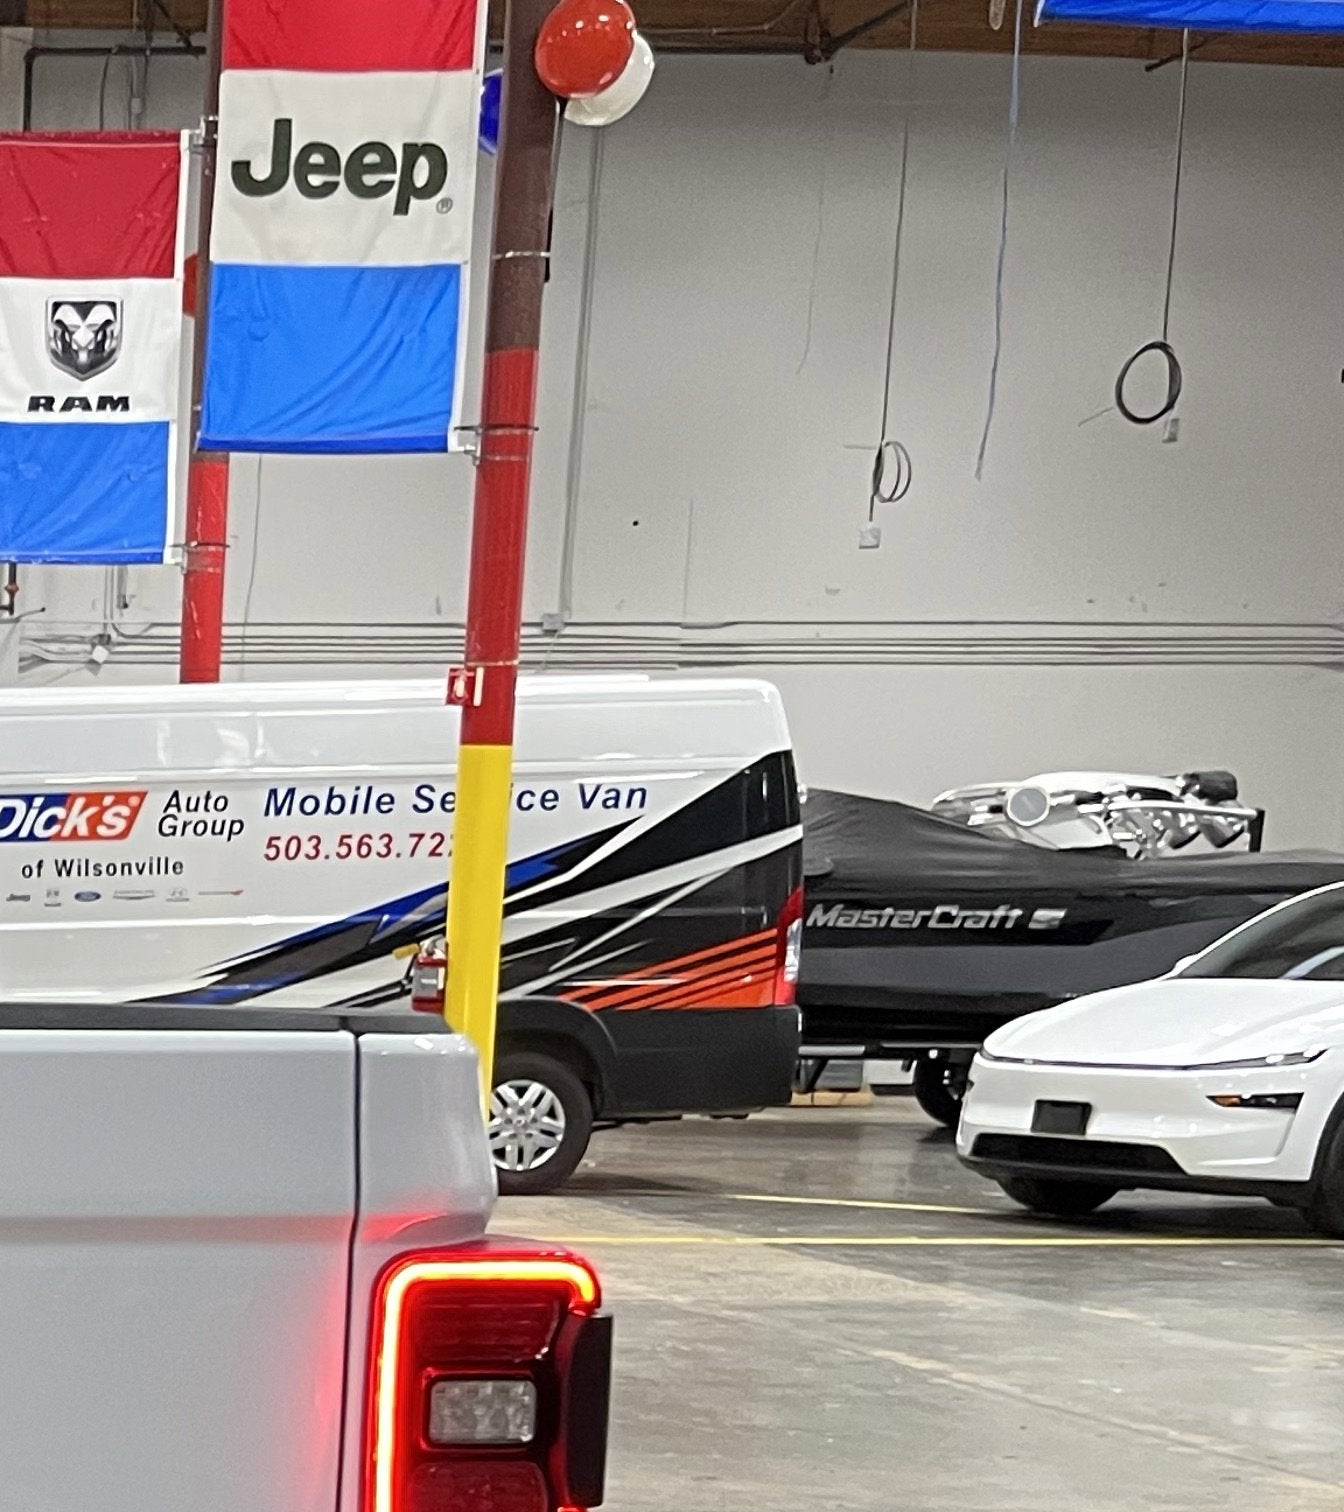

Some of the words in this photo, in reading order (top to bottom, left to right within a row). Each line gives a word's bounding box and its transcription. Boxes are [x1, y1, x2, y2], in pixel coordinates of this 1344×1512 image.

[230, 118, 449, 217] Jeep
[27, 394, 131, 414] RAM
[162, 789, 229, 814] Auto
[263, 784, 396, 817] Mobile
[579, 783, 647, 810] Van
[158, 813, 245, 842] Group
[263, 832, 453, 862] 503.563.72
[21, 858, 44, 879] of
[55, 856, 184, 878] Wilsonville
[806, 903, 1024, 929] MasterCraft
